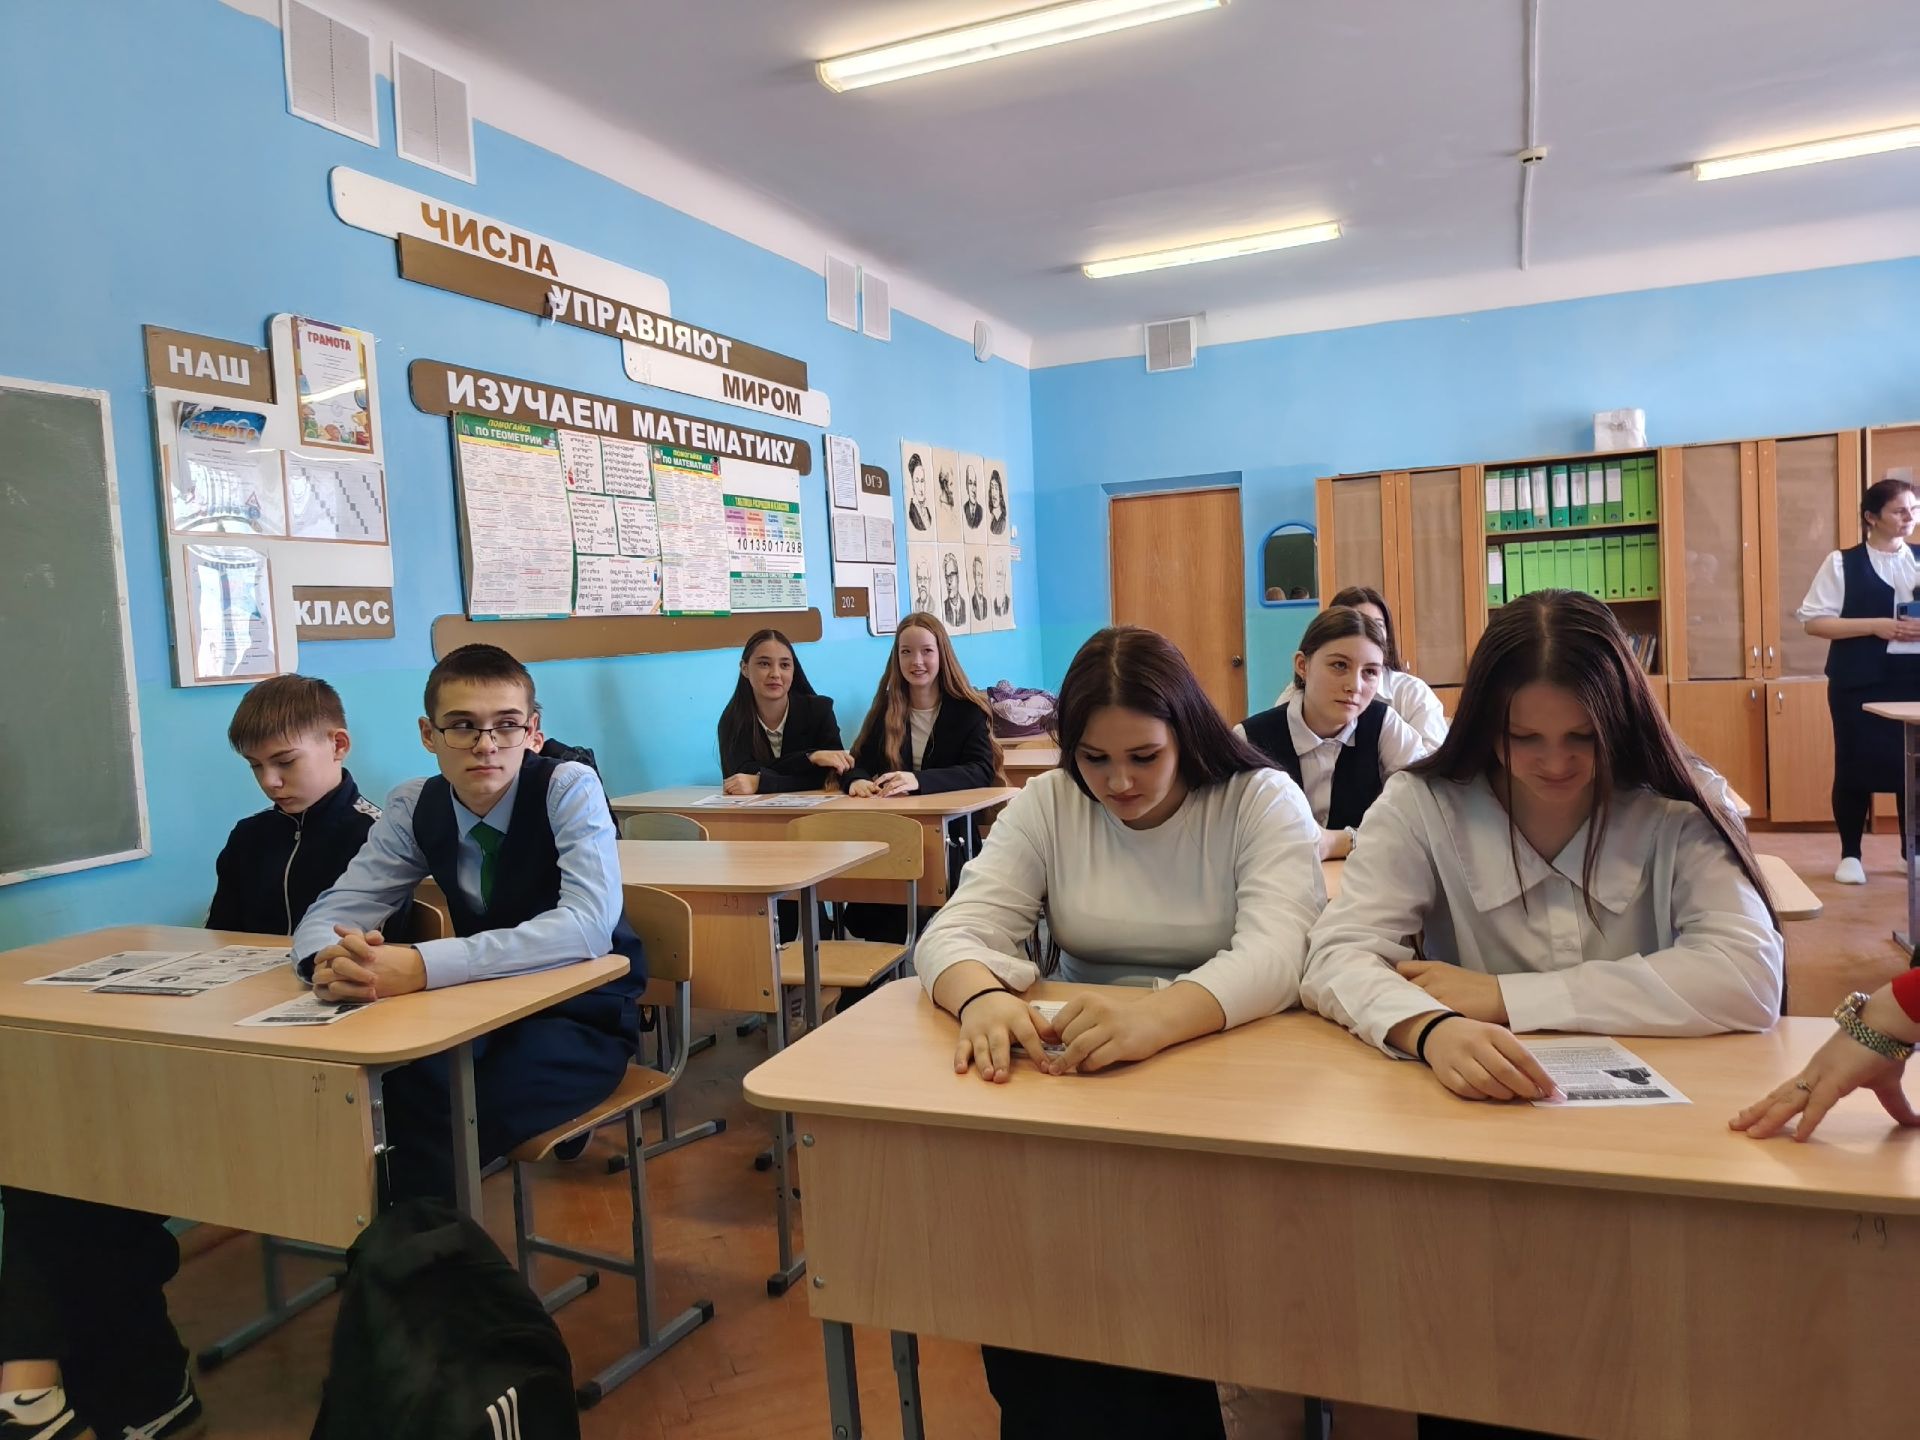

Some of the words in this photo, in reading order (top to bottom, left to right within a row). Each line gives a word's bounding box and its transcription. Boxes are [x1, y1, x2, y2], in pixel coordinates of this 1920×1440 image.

[421, 201, 559, 278] ЧИСЛА
[550, 284, 732, 364] УПРАВЛЯЮТ
[307, 331, 352, 351] ГРАМОТА
[167, 345, 250, 386] НАШ
[722, 373, 802, 416] МИРОМ
[447, 370, 618, 433] ИЗУЧАЕМ
[632, 409, 795, 465] МАТЕМАТИКУ
[475, 425, 489, 437] ПО
[490, 428, 543, 445] ГЕОМЕТРИИ
[662, 456, 672, 464] ПО
[673, 457, 713, 471] МАТЕМАТИКЕ
[864, 473, 883, 489] ОГЭ
[297, 600, 391, 626] КЛАСС
